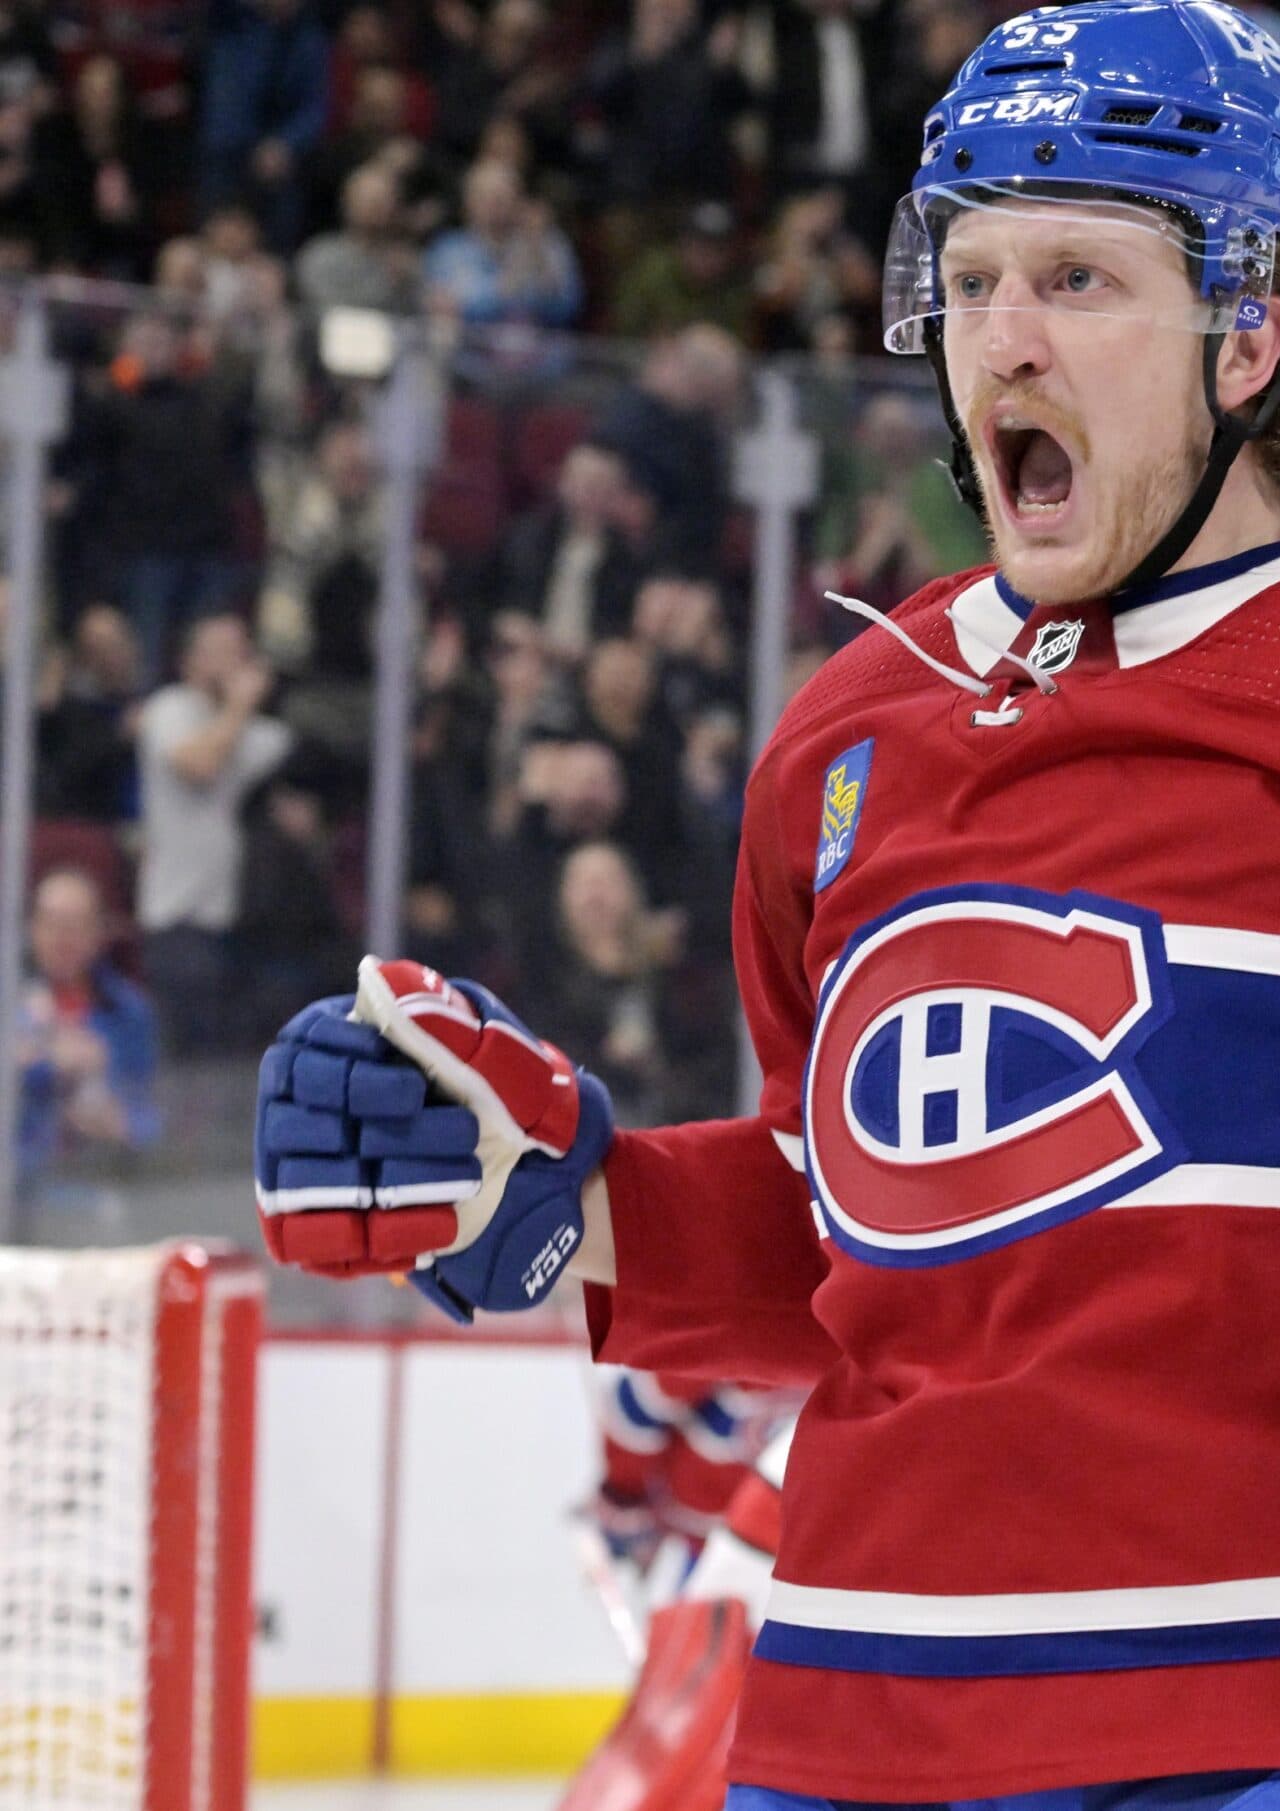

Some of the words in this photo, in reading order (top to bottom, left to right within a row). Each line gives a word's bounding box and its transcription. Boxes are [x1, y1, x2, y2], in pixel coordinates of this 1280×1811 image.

[958, 95, 1077, 125] CCM
[817, 832, 848, 880] RBC
[526, 1225, 578, 1299] CCM
